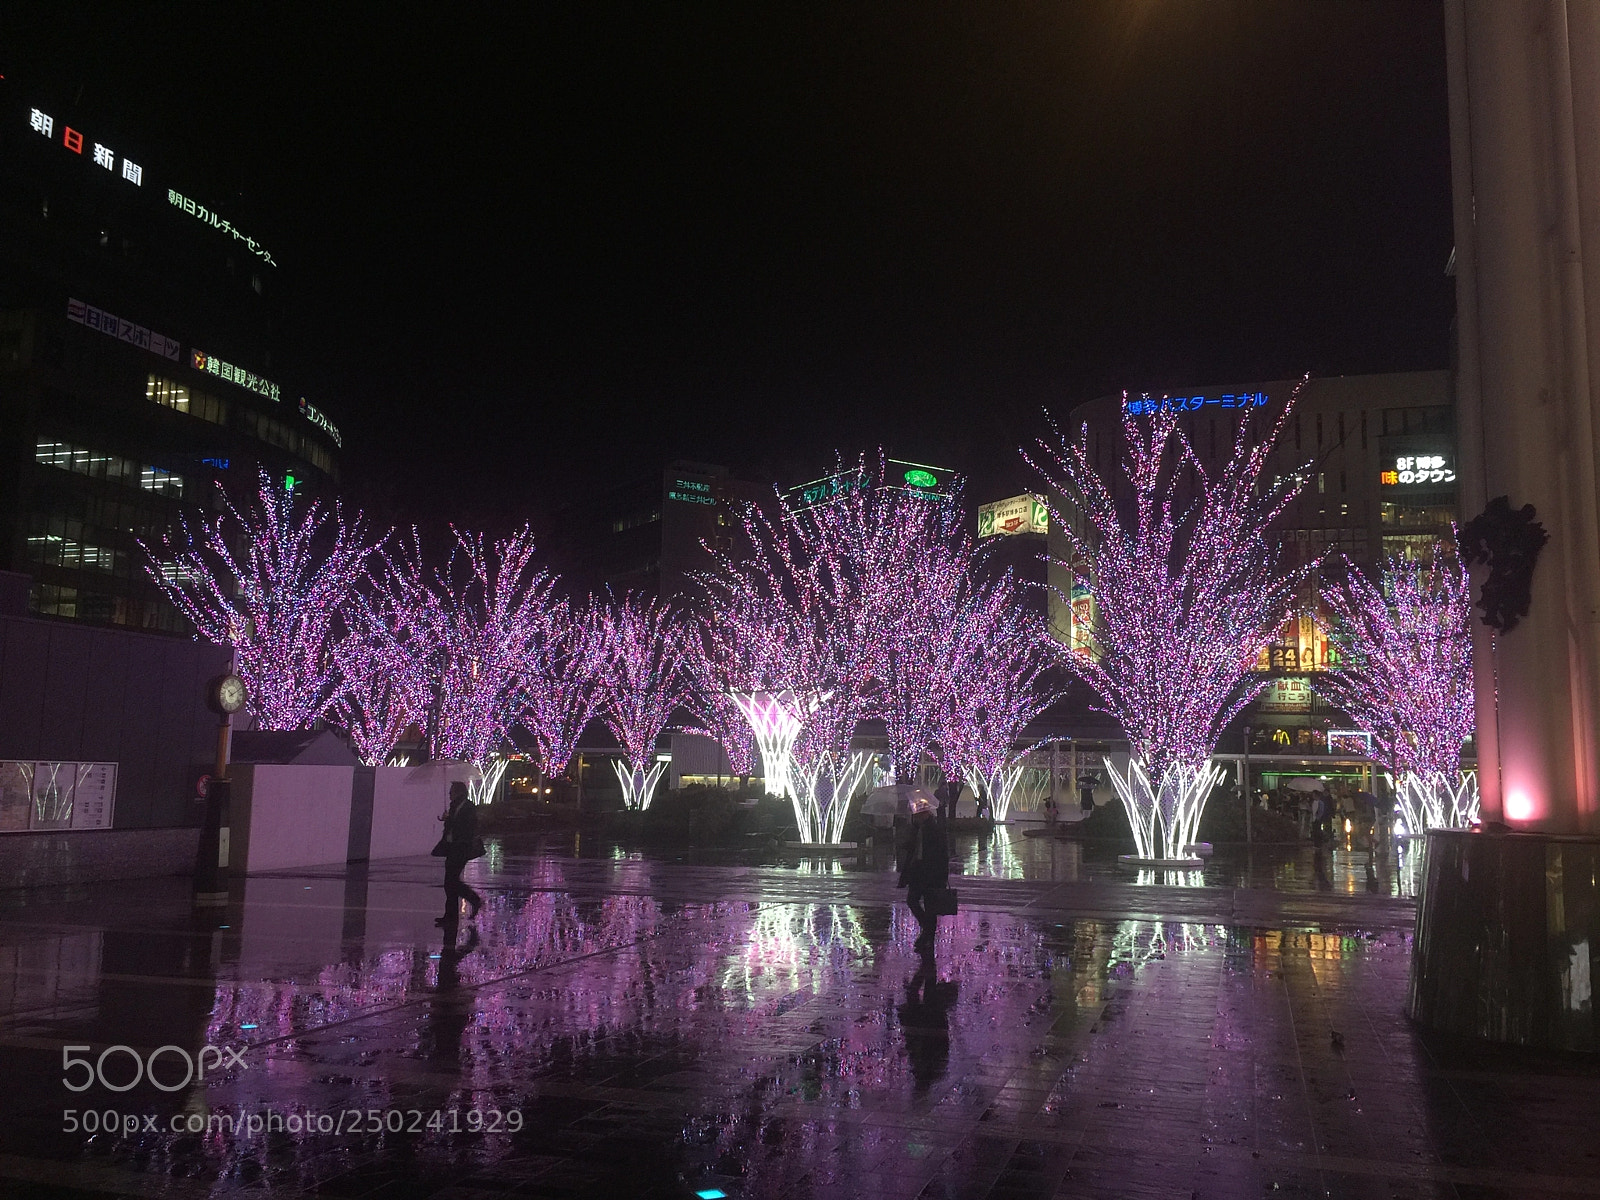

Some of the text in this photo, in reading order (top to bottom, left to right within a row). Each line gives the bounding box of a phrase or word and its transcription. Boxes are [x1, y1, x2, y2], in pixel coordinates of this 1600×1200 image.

[29, 107, 143, 187] 朝日新聞
[168, 188, 278, 267] 朝日カルチャーセンター
[86, 308, 179, 356] 日刊スポーツ
[206, 355, 281, 402] 韓国観光公社
[1381, 469, 1456, 485] 味のタウン
[1273, 649, 1296, 661] 24
